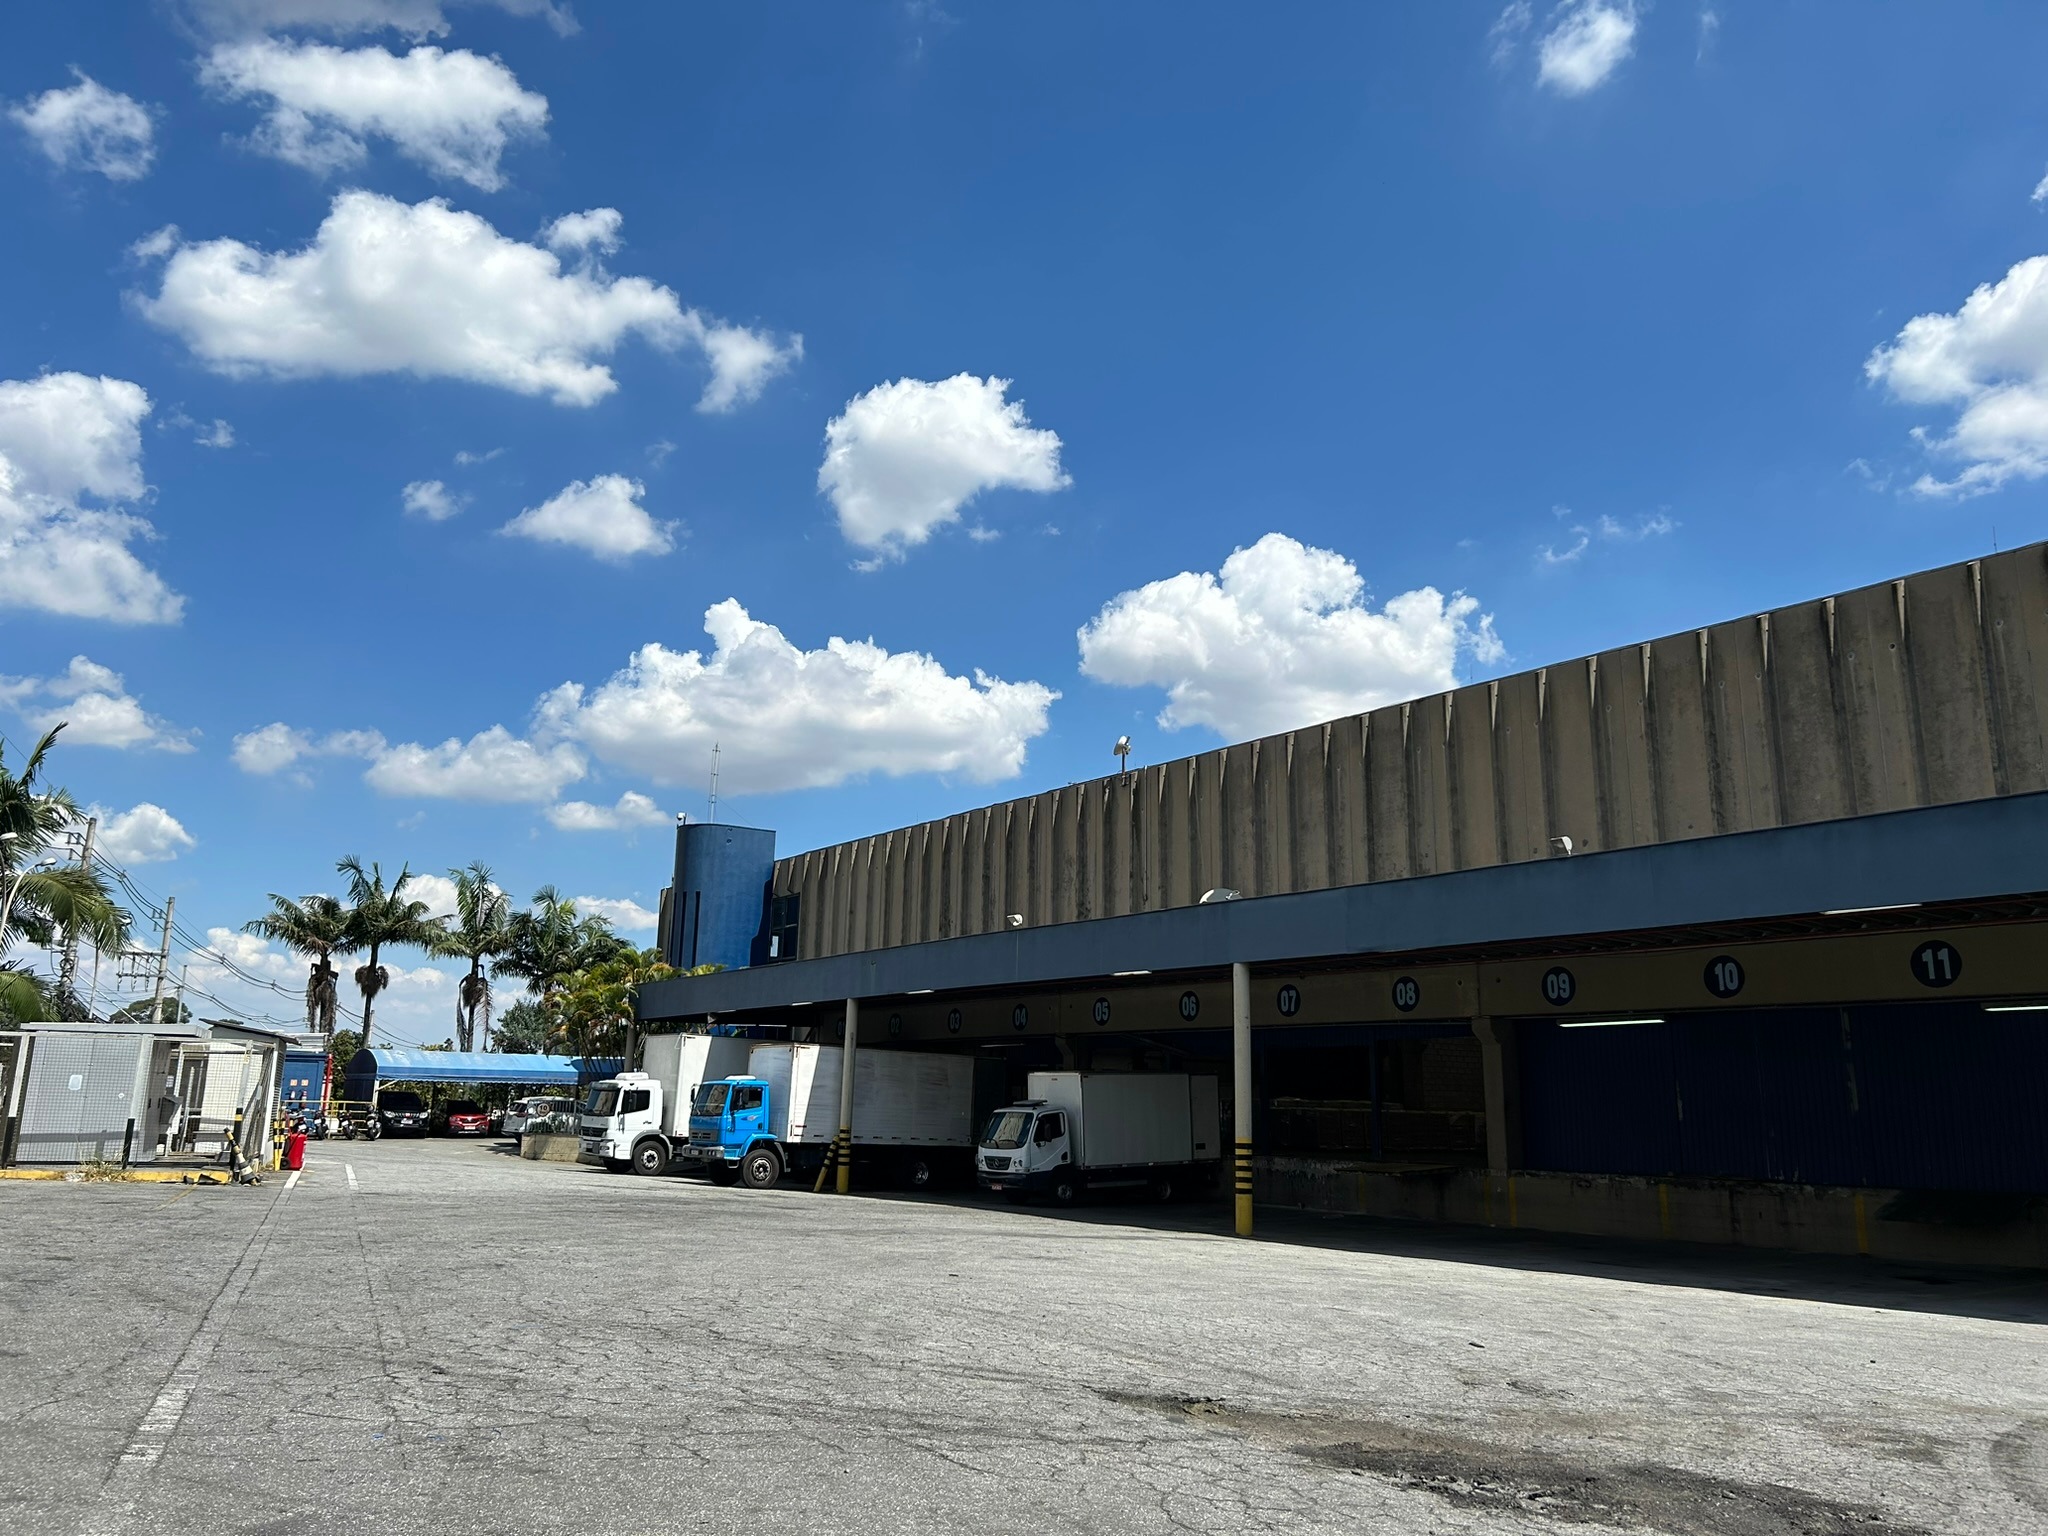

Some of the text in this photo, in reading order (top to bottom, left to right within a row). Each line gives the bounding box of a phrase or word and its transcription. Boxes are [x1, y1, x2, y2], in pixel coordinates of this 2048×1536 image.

[1921, 948, 1953, 981] 11
[1547, 973, 1571, 999] 09
[1714, 962, 1740, 991] 10
[1280, 989, 1298, 1013] 07
[1396, 982, 1416, 1007] 08
[1014, 1007, 1027, 1026] 04
[1094, 1002, 1109, 1022] 05
[1181, 996, 1197, 1017] 06
[890, 1016, 901, 1034] 02
[949, 1012, 961, 1029] 03
